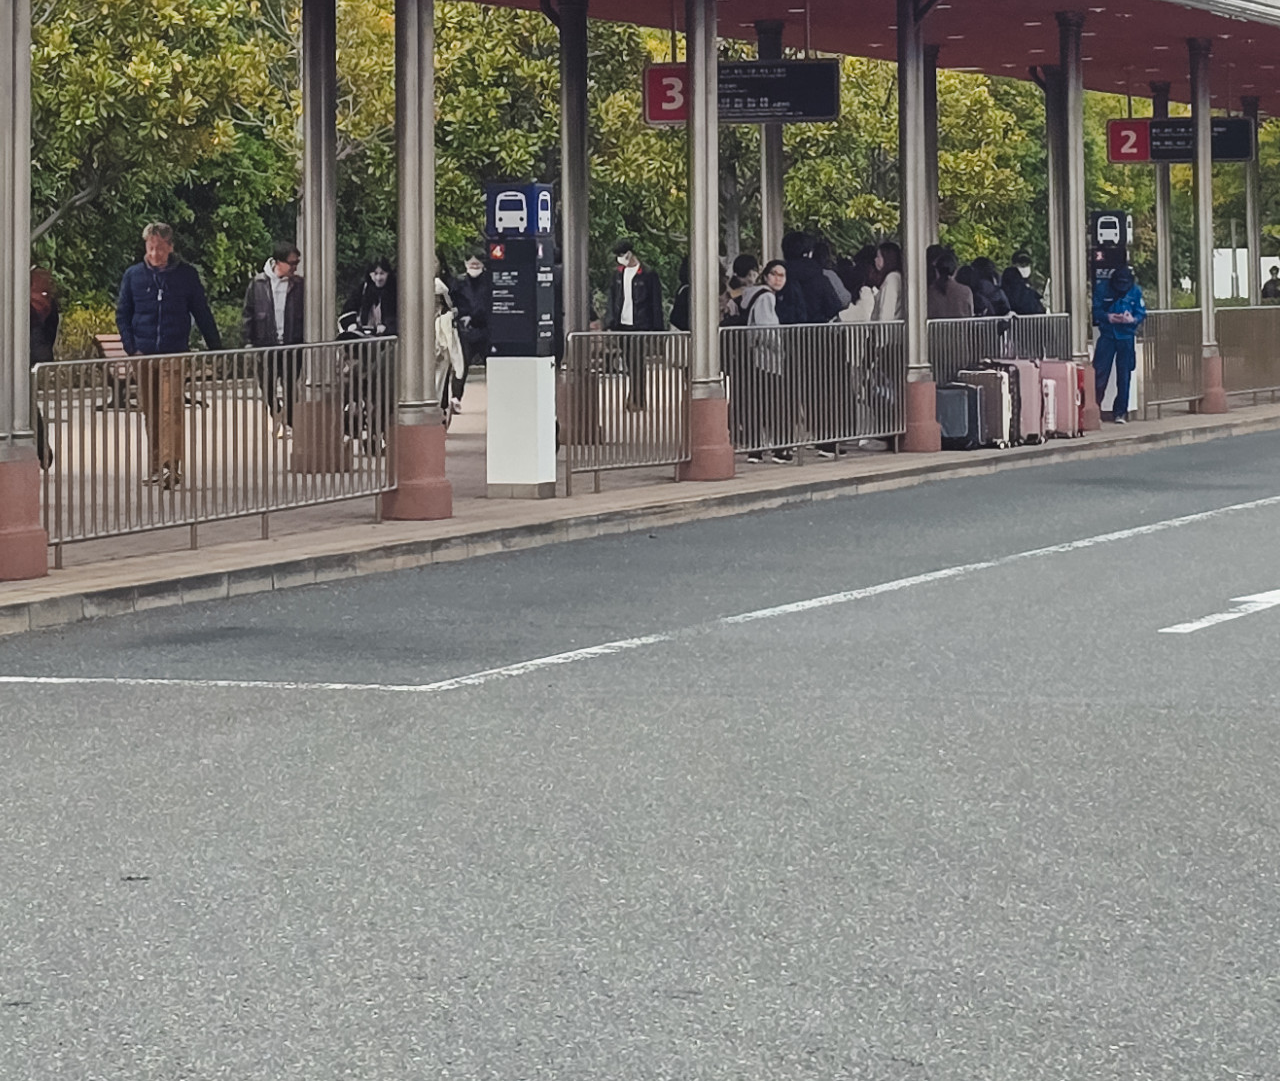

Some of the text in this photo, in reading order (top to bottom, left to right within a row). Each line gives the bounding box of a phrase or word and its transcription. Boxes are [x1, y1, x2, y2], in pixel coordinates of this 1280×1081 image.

[662, 77, 684, 110] 3
[1120, 130, 1138, 154] 2
[492, 246, 503, 257] 4
